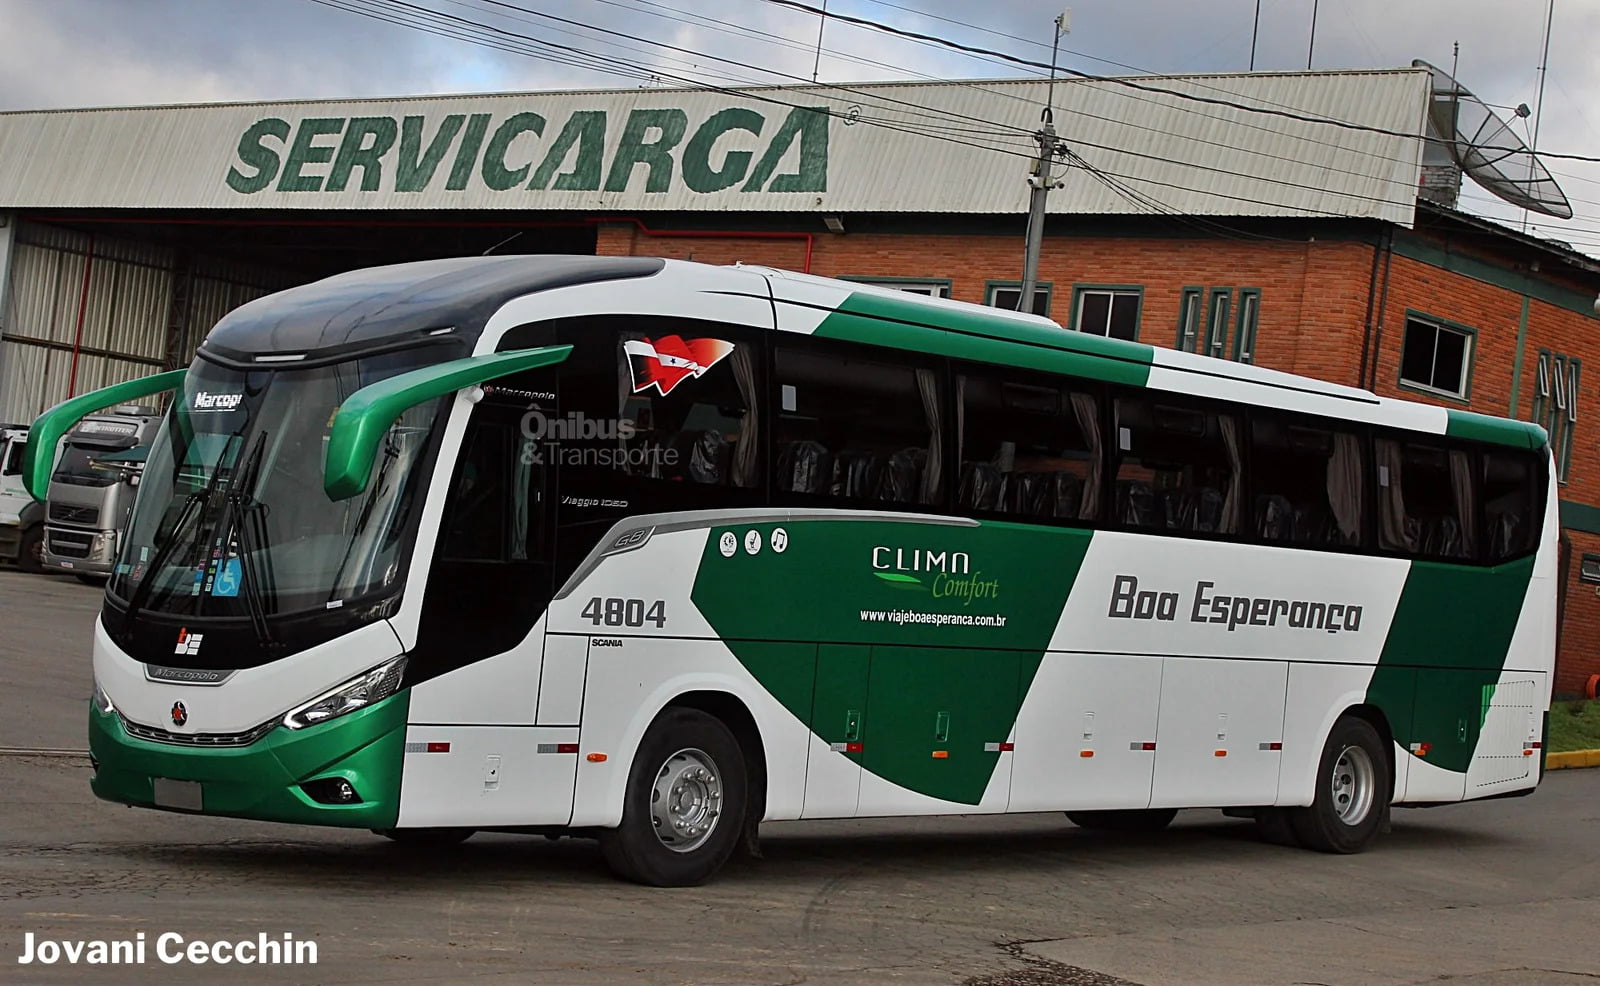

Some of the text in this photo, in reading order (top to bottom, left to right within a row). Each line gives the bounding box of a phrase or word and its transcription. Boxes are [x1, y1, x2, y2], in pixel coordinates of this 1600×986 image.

[225, 106, 830, 194] SERVICARGA
[495, 386, 556, 400] Marcopolo
[562, 495, 599, 507] Viaggio
[872, 546, 969, 574] CLIMA
[932, 571, 999, 606] Comfort
[581, 597, 666, 628] 4804
[1108, 575, 1363, 634] Boa Esperança
[860, 609, 1006, 627] wwwviajeboaesperanca.com.br
[592, 639, 623, 647] SCANIA
[154, 668, 219, 681] Marcopolo
